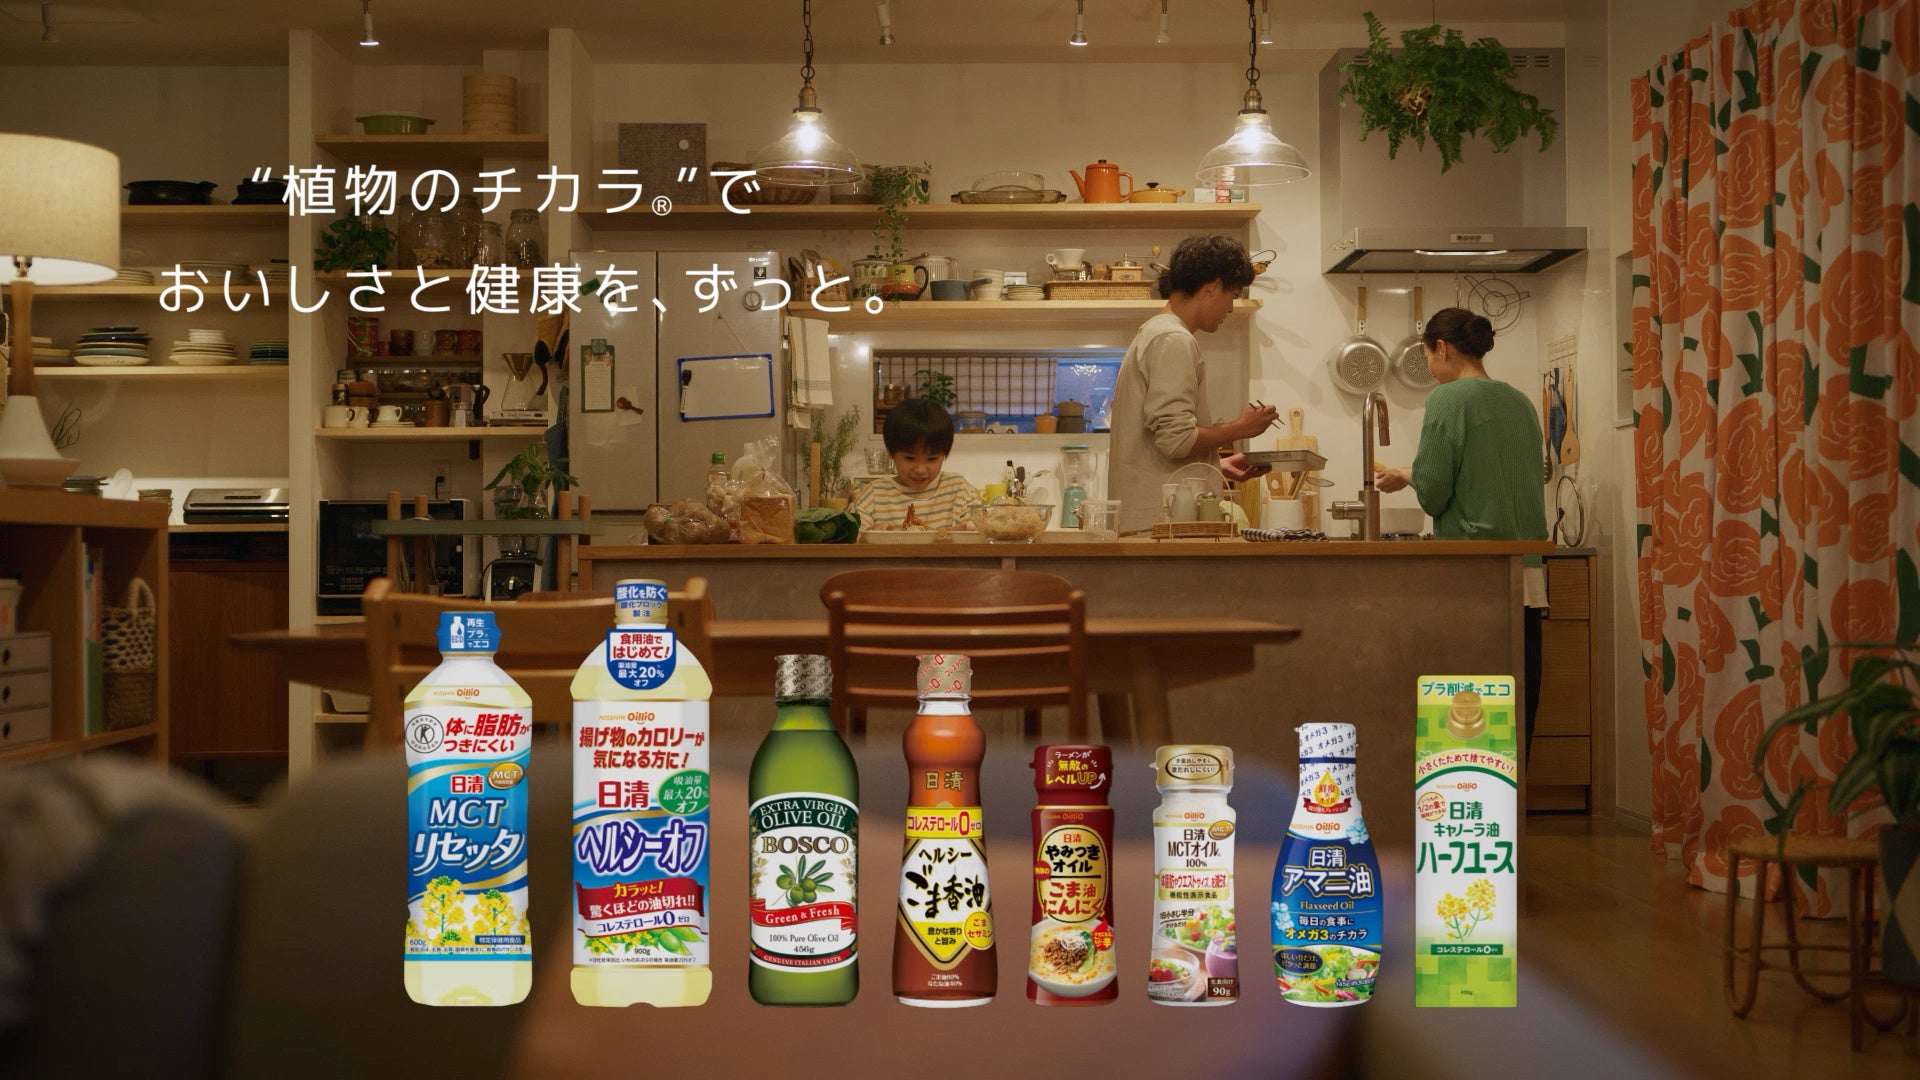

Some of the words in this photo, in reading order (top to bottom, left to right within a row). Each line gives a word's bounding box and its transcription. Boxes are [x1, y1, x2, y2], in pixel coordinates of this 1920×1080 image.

[614, 585, 668, 600] 酸化を防ぐ
[620, 601, 663, 609] 酸化ブロック
[466, 618, 485, 628] 再生
[467, 640, 490, 649] でエコ
[620, 633, 663, 645] 食用油で
[612, 645, 671, 660] はじめて!
[633, 679, 650, 688] オフ
[1421, 681, 1511, 697] プラ削減でエコ
[456, 688, 480, 697] OilliO
[627, 712, 656, 722] OilliO
[445, 713, 531, 737] 体に脂肪が
[579, 726, 706, 748] 揚げ物のカロリーが
[443, 739, 515, 753] つきにくい
[592, 749, 690, 769] 気になる方に!
[1054, 750, 1093, 759] ラーメンが
[1057, 760, 1089, 771] 無敵の
[1418, 752, 1515, 775] 小さくたためて捨てやすい!
[492, 769, 520, 780] MCT
[673, 775, 703, 786] 吸油量
[926, 770, 964, 791] 日清
[1045, 771, 1098, 785] レベルUP
[450, 774, 484, 794] 日清
[597, 779, 651, 809] 日清
[428, 798, 506, 825] MCT
[675, 800, 699, 814] オフ
[760, 799, 800, 817] EXTRA
[802, 799, 848, 817] VIRGIN
[1449, 801, 1483, 820] 日清
[761, 810, 813, 829] OLIVE
[816, 811, 845, 830] OIL
[1315, 822, 1341, 831] OilliO
[1183, 828, 1206, 841] 日清
[1433, 821, 1500, 838] キャノーラ油
[761, 836, 849, 854] BOSCO
[1063, 833, 1082, 843] 日清
[412, 827, 522, 873] リセッタ
[577, 818, 706, 874] ヘルシーオフ
[1045, 844, 1100, 861] やみつき
[918, 847, 973, 864] ヘルシー
[1311, 848, 1344, 868] 日清
[1416, 840, 1516, 875] ハーフユース
[1052, 859, 1093, 873] オイル
[1185, 858, 1207, 868] 100%
[1283, 866, 1372, 895] アマニ油
[613, 880, 664, 899] カラッと!
[904, 863, 985, 919] ごま香油
[1049, 880, 1097, 898] ごま油
[589, 894, 696, 919] 驚くほどの油切れ!!
[1043, 897, 1105, 915] にんにく
[1300, 901, 1339, 910] Flaxseed
[1340, 901, 1355, 910] Oil
[765, 913, 798, 924] Green
[809, 905, 840, 919] Fresh
[1298, 915, 1354, 927] 毎日の食事に
[769, 934, 788, 942] 100%
[789, 934, 806, 943] Pure
[807, 934, 827, 942] Olive
[827, 934, 839, 942] Oil
[927, 927, 963, 936] 豊かな香り
[967, 929, 993, 938] セサミン
[1284, 928, 1368, 941] オメガ3のチカラ
[409, 938, 427, 948] 600g
[633, 948, 652, 956] 900g
[763, 955, 793, 966] GENUINE
[822, 956, 842, 965] TASTE
[1212, 987, 1231, 996] 90g
